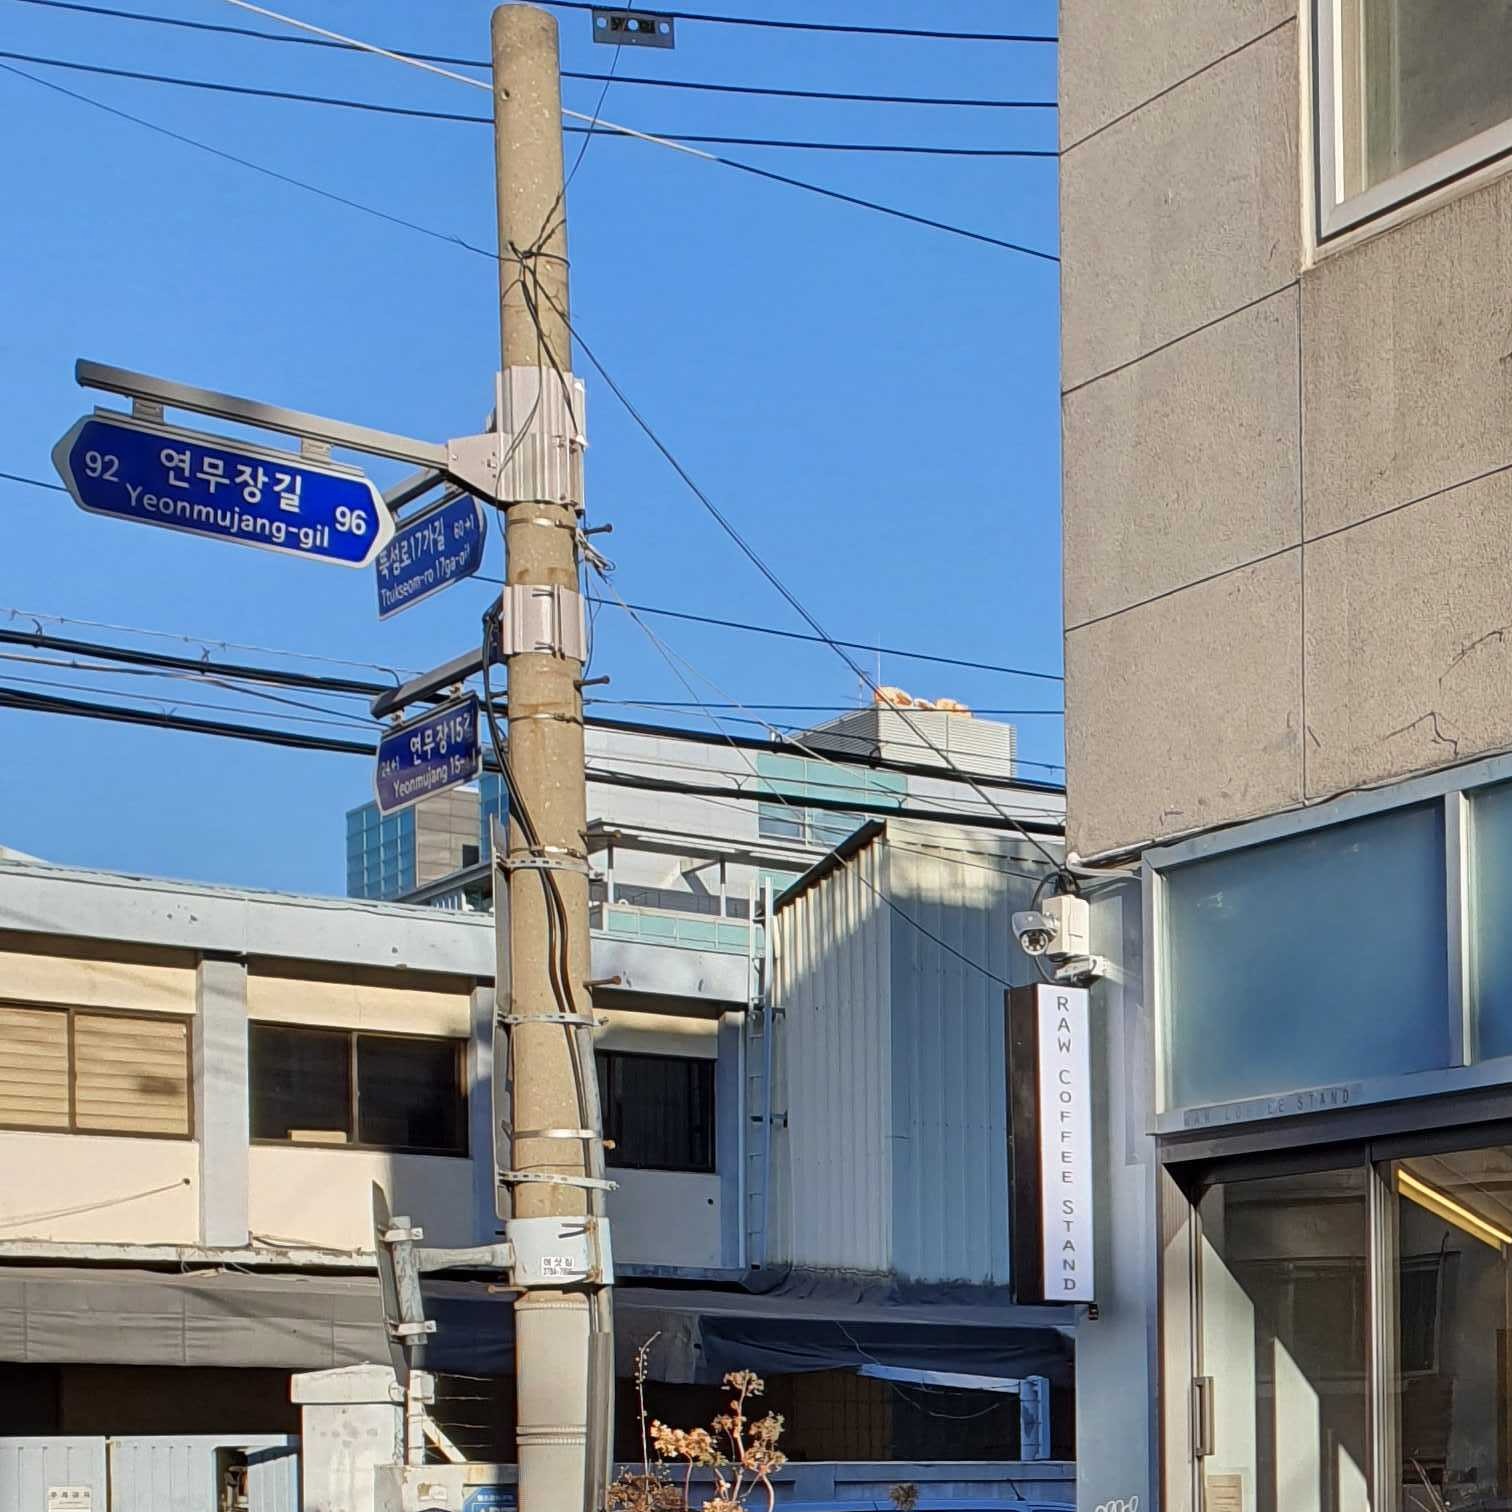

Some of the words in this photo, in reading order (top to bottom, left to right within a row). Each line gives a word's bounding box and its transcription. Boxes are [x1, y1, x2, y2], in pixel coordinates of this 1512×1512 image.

[84, 451, 119, 482] 92
[160, 449, 303, 513] 연무장길
[125, 483, 329, 548] Yeonmujang-gil
[335, 506, 367, 535] 96
[393, 765, 448, 798] Yeonmujang
[1056, 994, 1072, 1053] RAW
[1058, 1069, 1072, 1184] COFFEE
[1062, 1199, 1076, 1291] STAND
